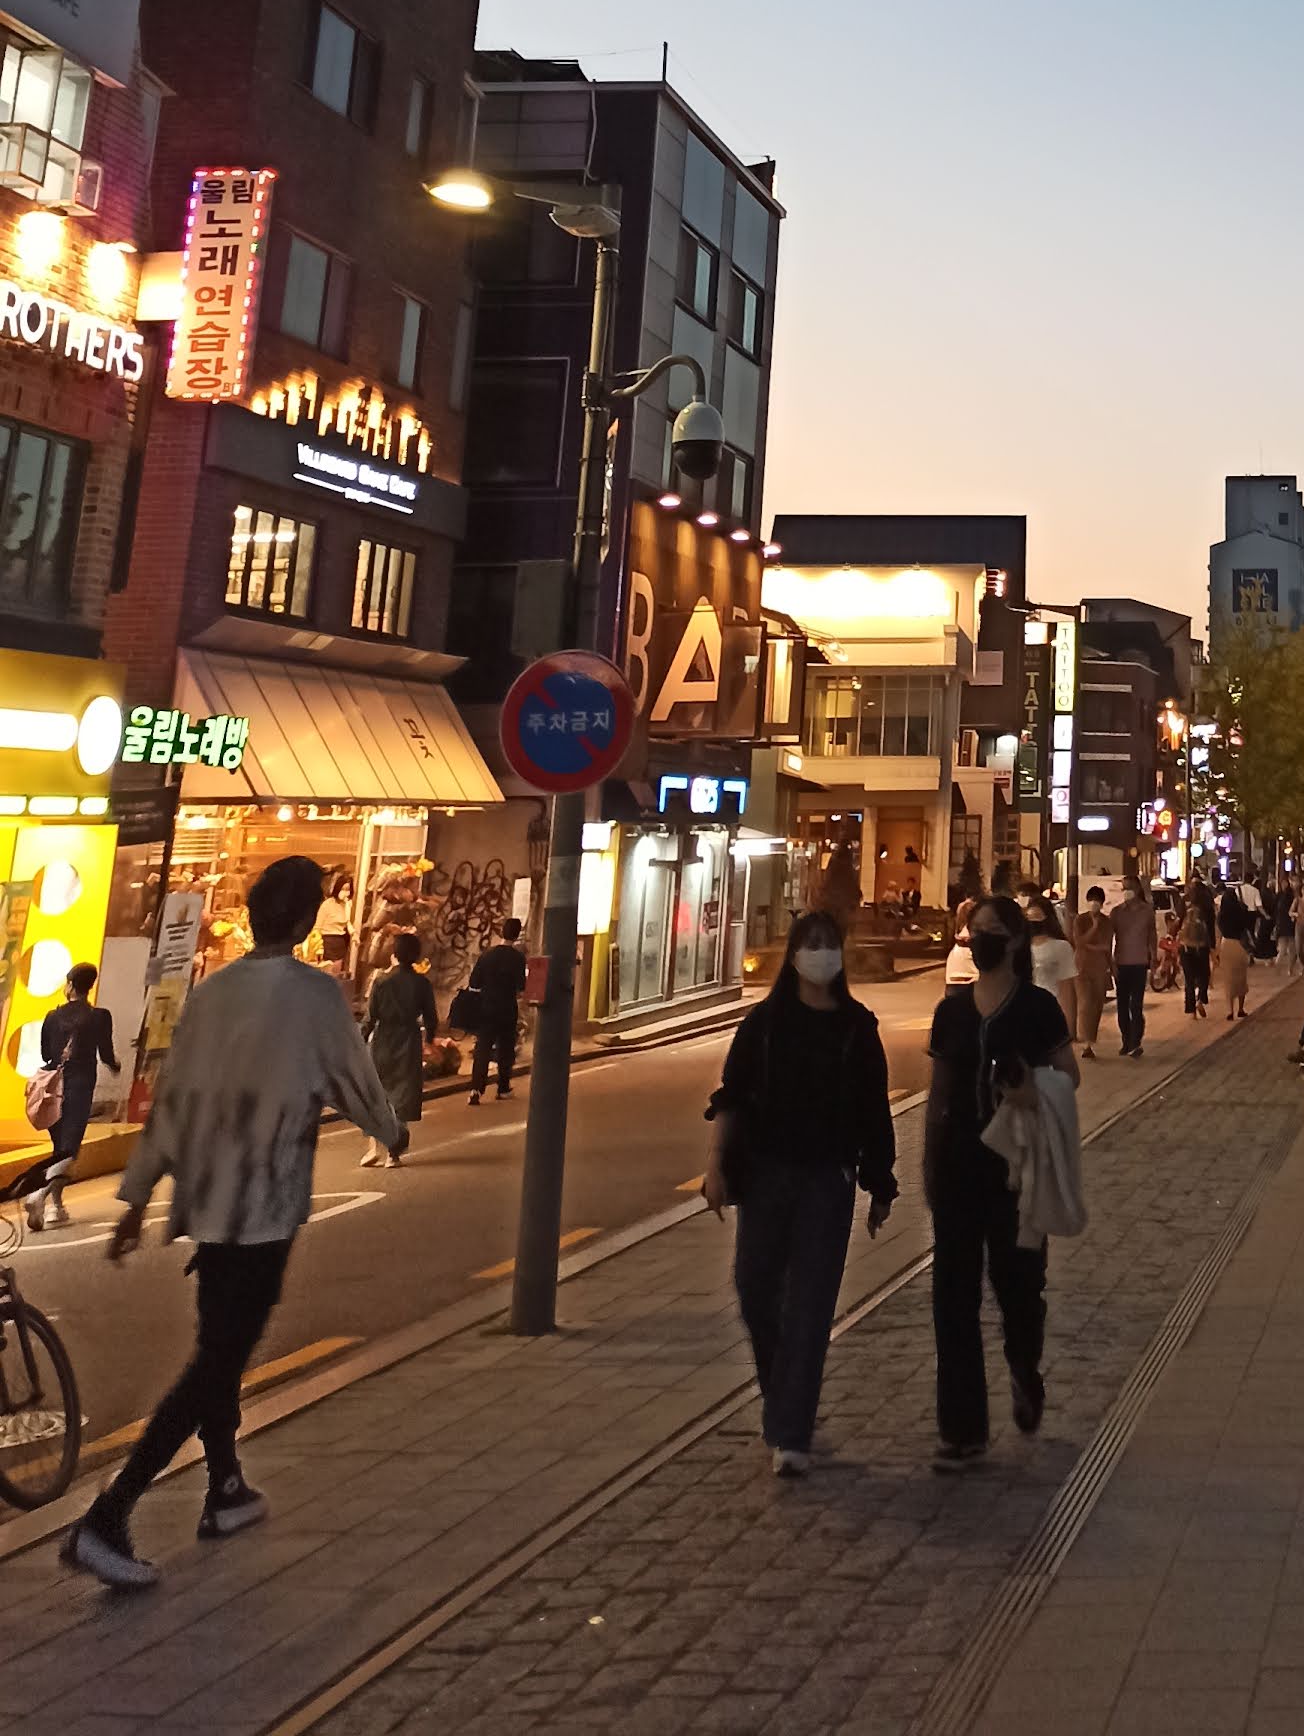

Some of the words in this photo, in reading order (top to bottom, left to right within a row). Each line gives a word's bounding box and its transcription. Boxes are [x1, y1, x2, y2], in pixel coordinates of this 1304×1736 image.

[201, 179, 255, 204] 울림
[0, 278, 144, 381] ROTHERS
[624, 572, 748, 721] BA
[1057, 627, 1070, 706] TATTOO
[527, 709, 610, 736] 주차금지
[1024, 671, 1040, 746] TATT
